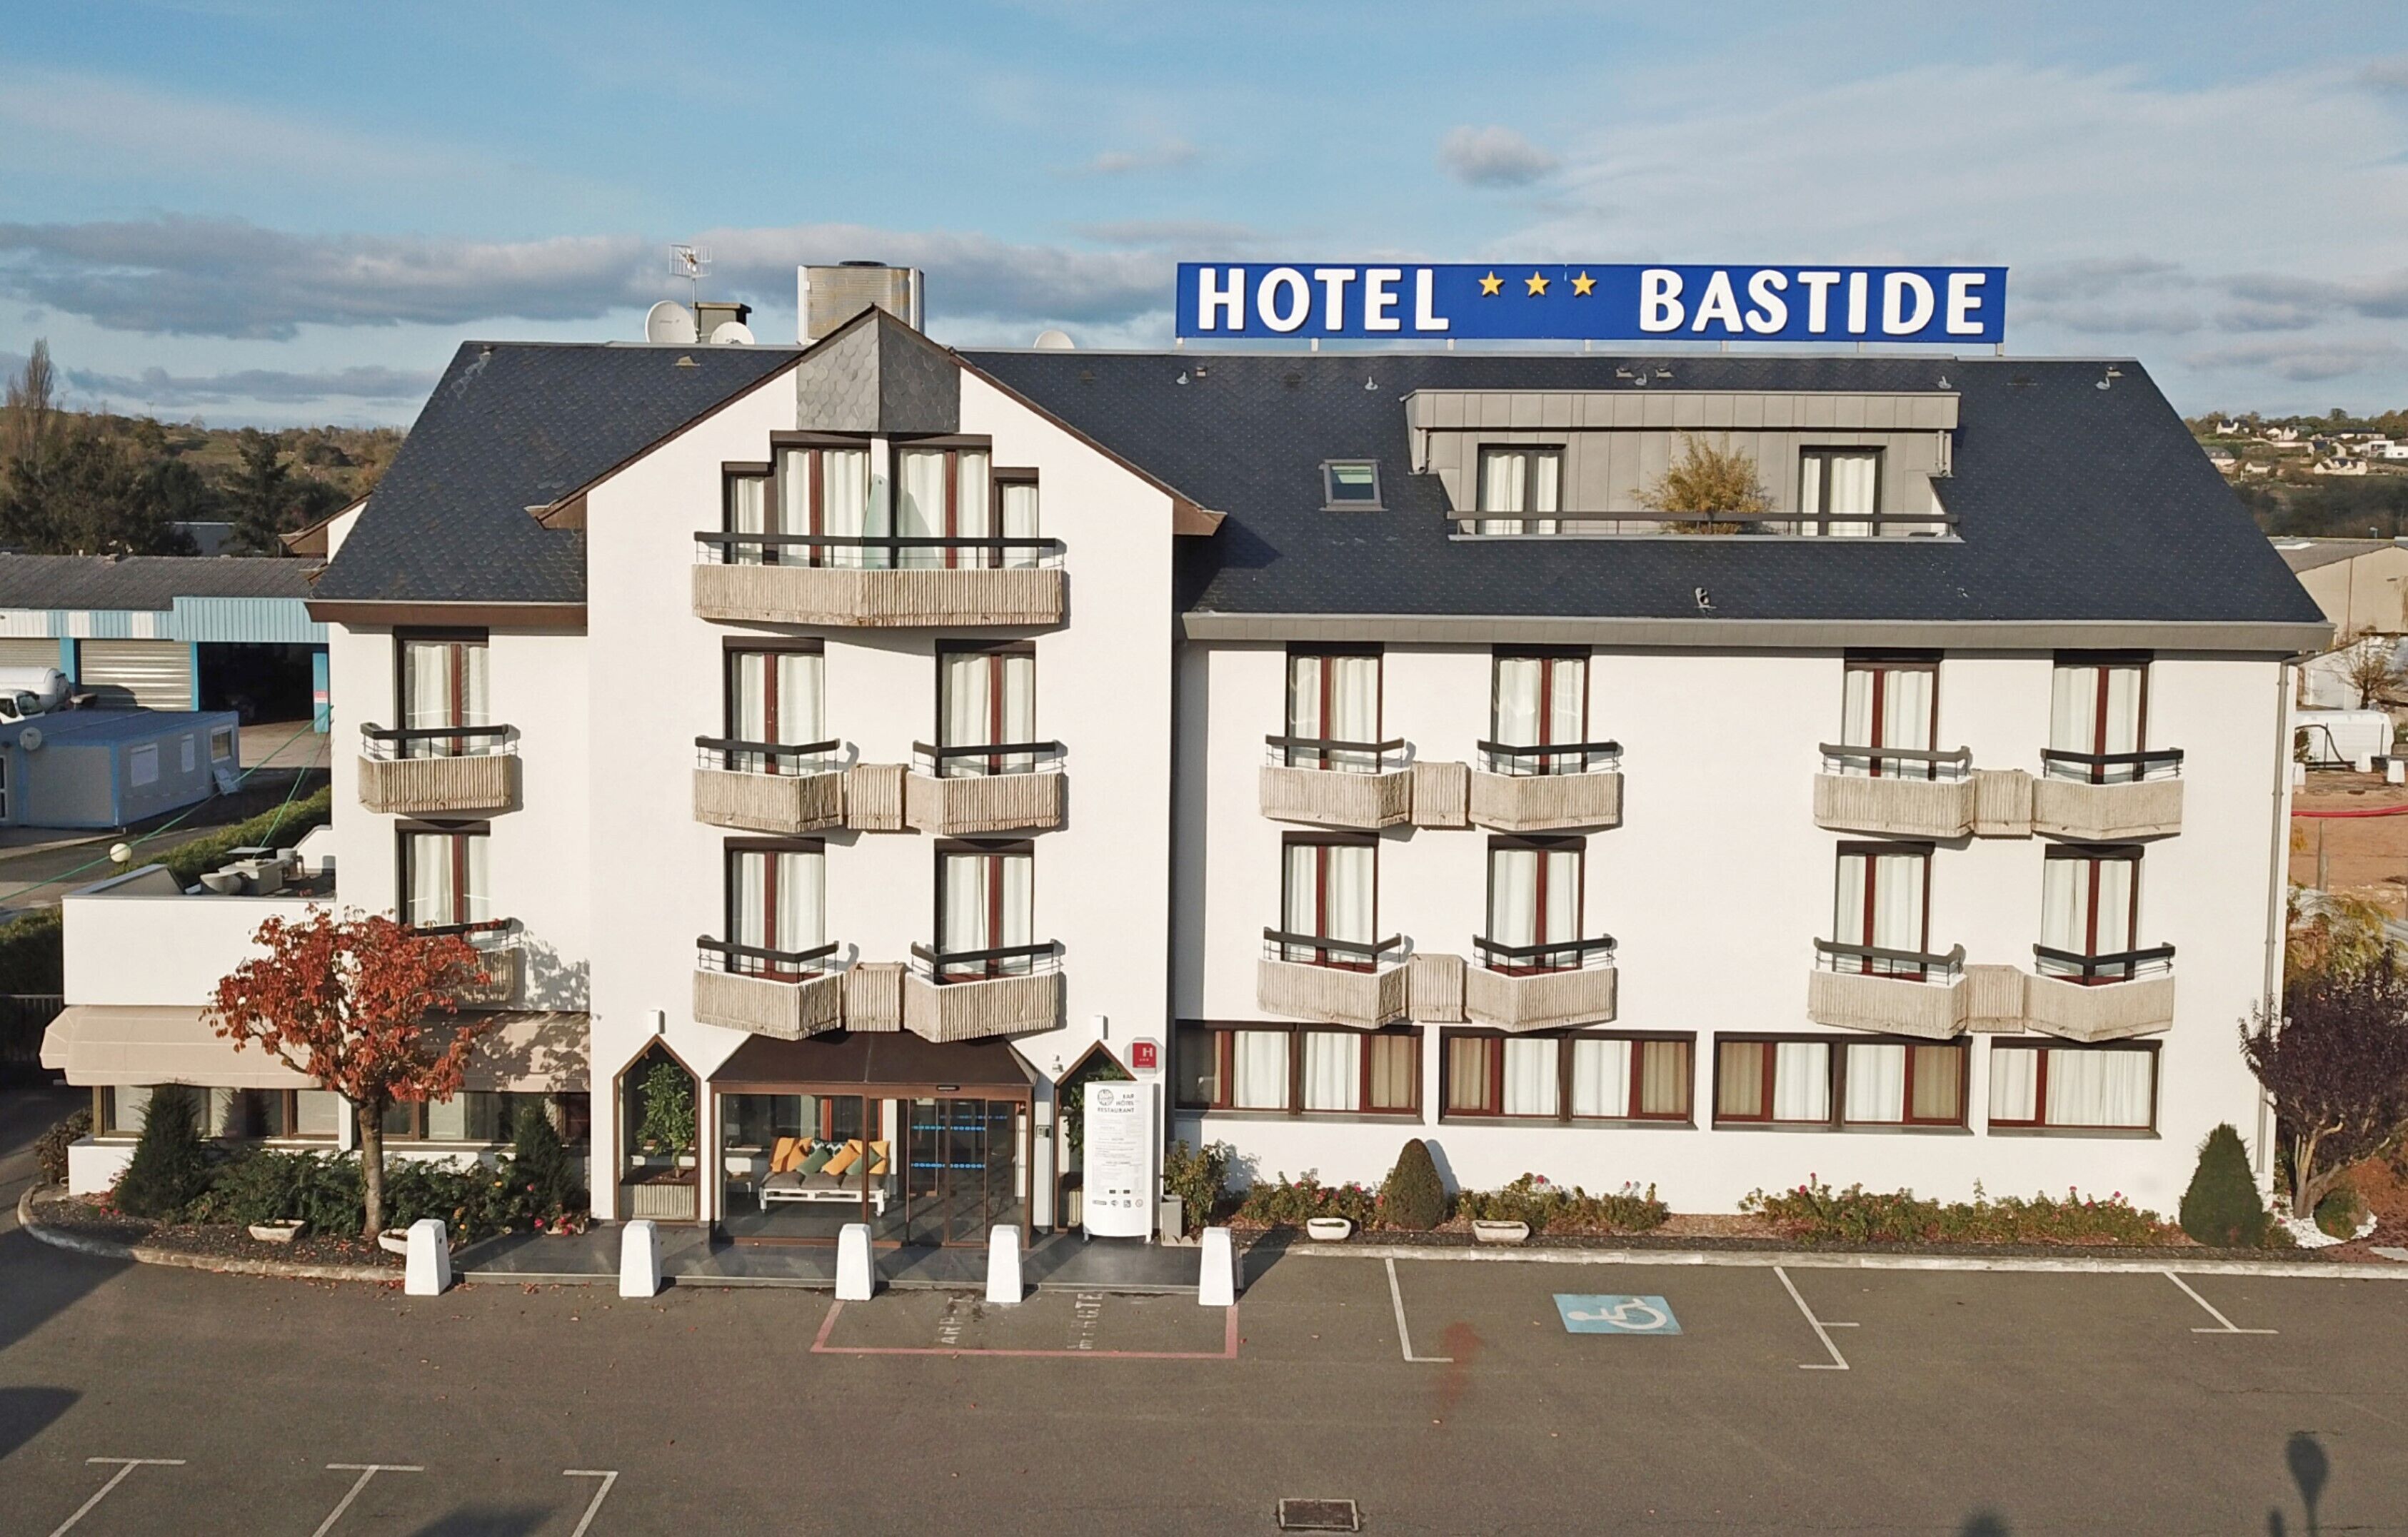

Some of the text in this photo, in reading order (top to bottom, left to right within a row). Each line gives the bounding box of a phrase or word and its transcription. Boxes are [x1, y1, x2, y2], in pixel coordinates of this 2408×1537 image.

[1197, 267, 1987, 335] HOTEL BASTIDE
[1143, 1047, 1153, 1057] H
